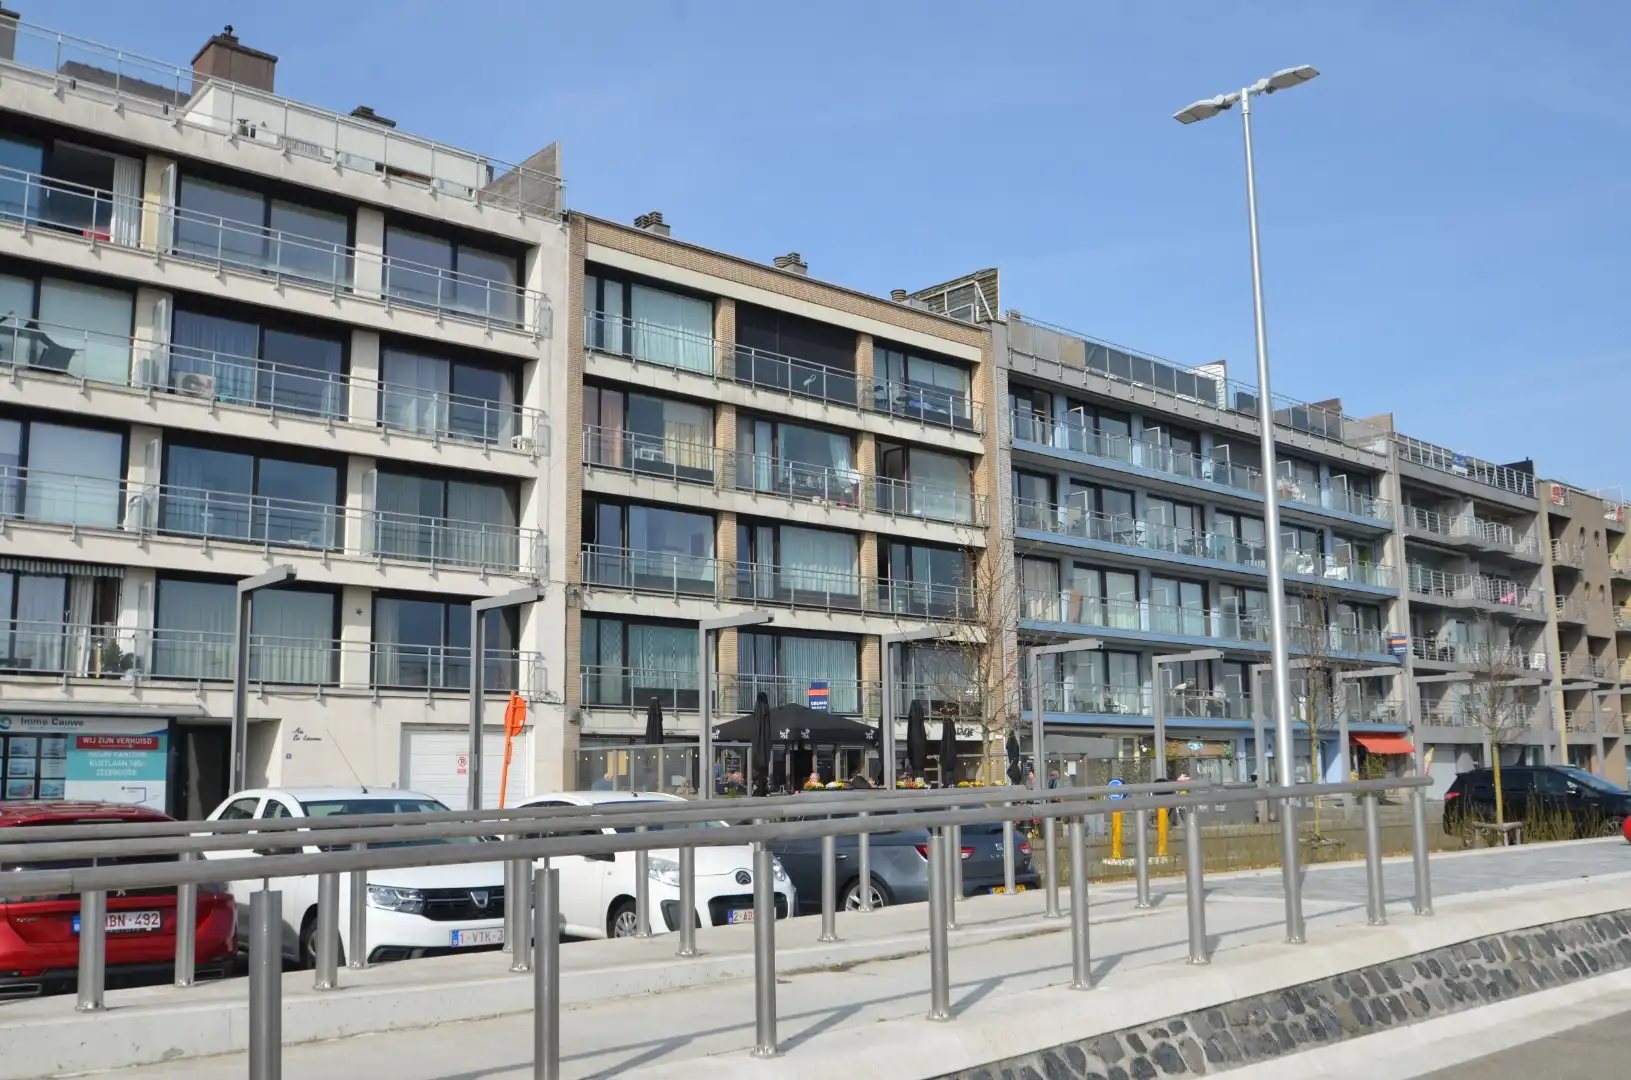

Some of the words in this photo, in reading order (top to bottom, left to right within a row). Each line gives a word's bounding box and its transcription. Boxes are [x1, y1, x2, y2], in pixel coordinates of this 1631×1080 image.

[21, 715, 48, 726] Immo
[51, 717, 84, 726] Cauwe
[82, 736, 96, 744] WIJ
[116, 737, 152, 745] VERHUISD
